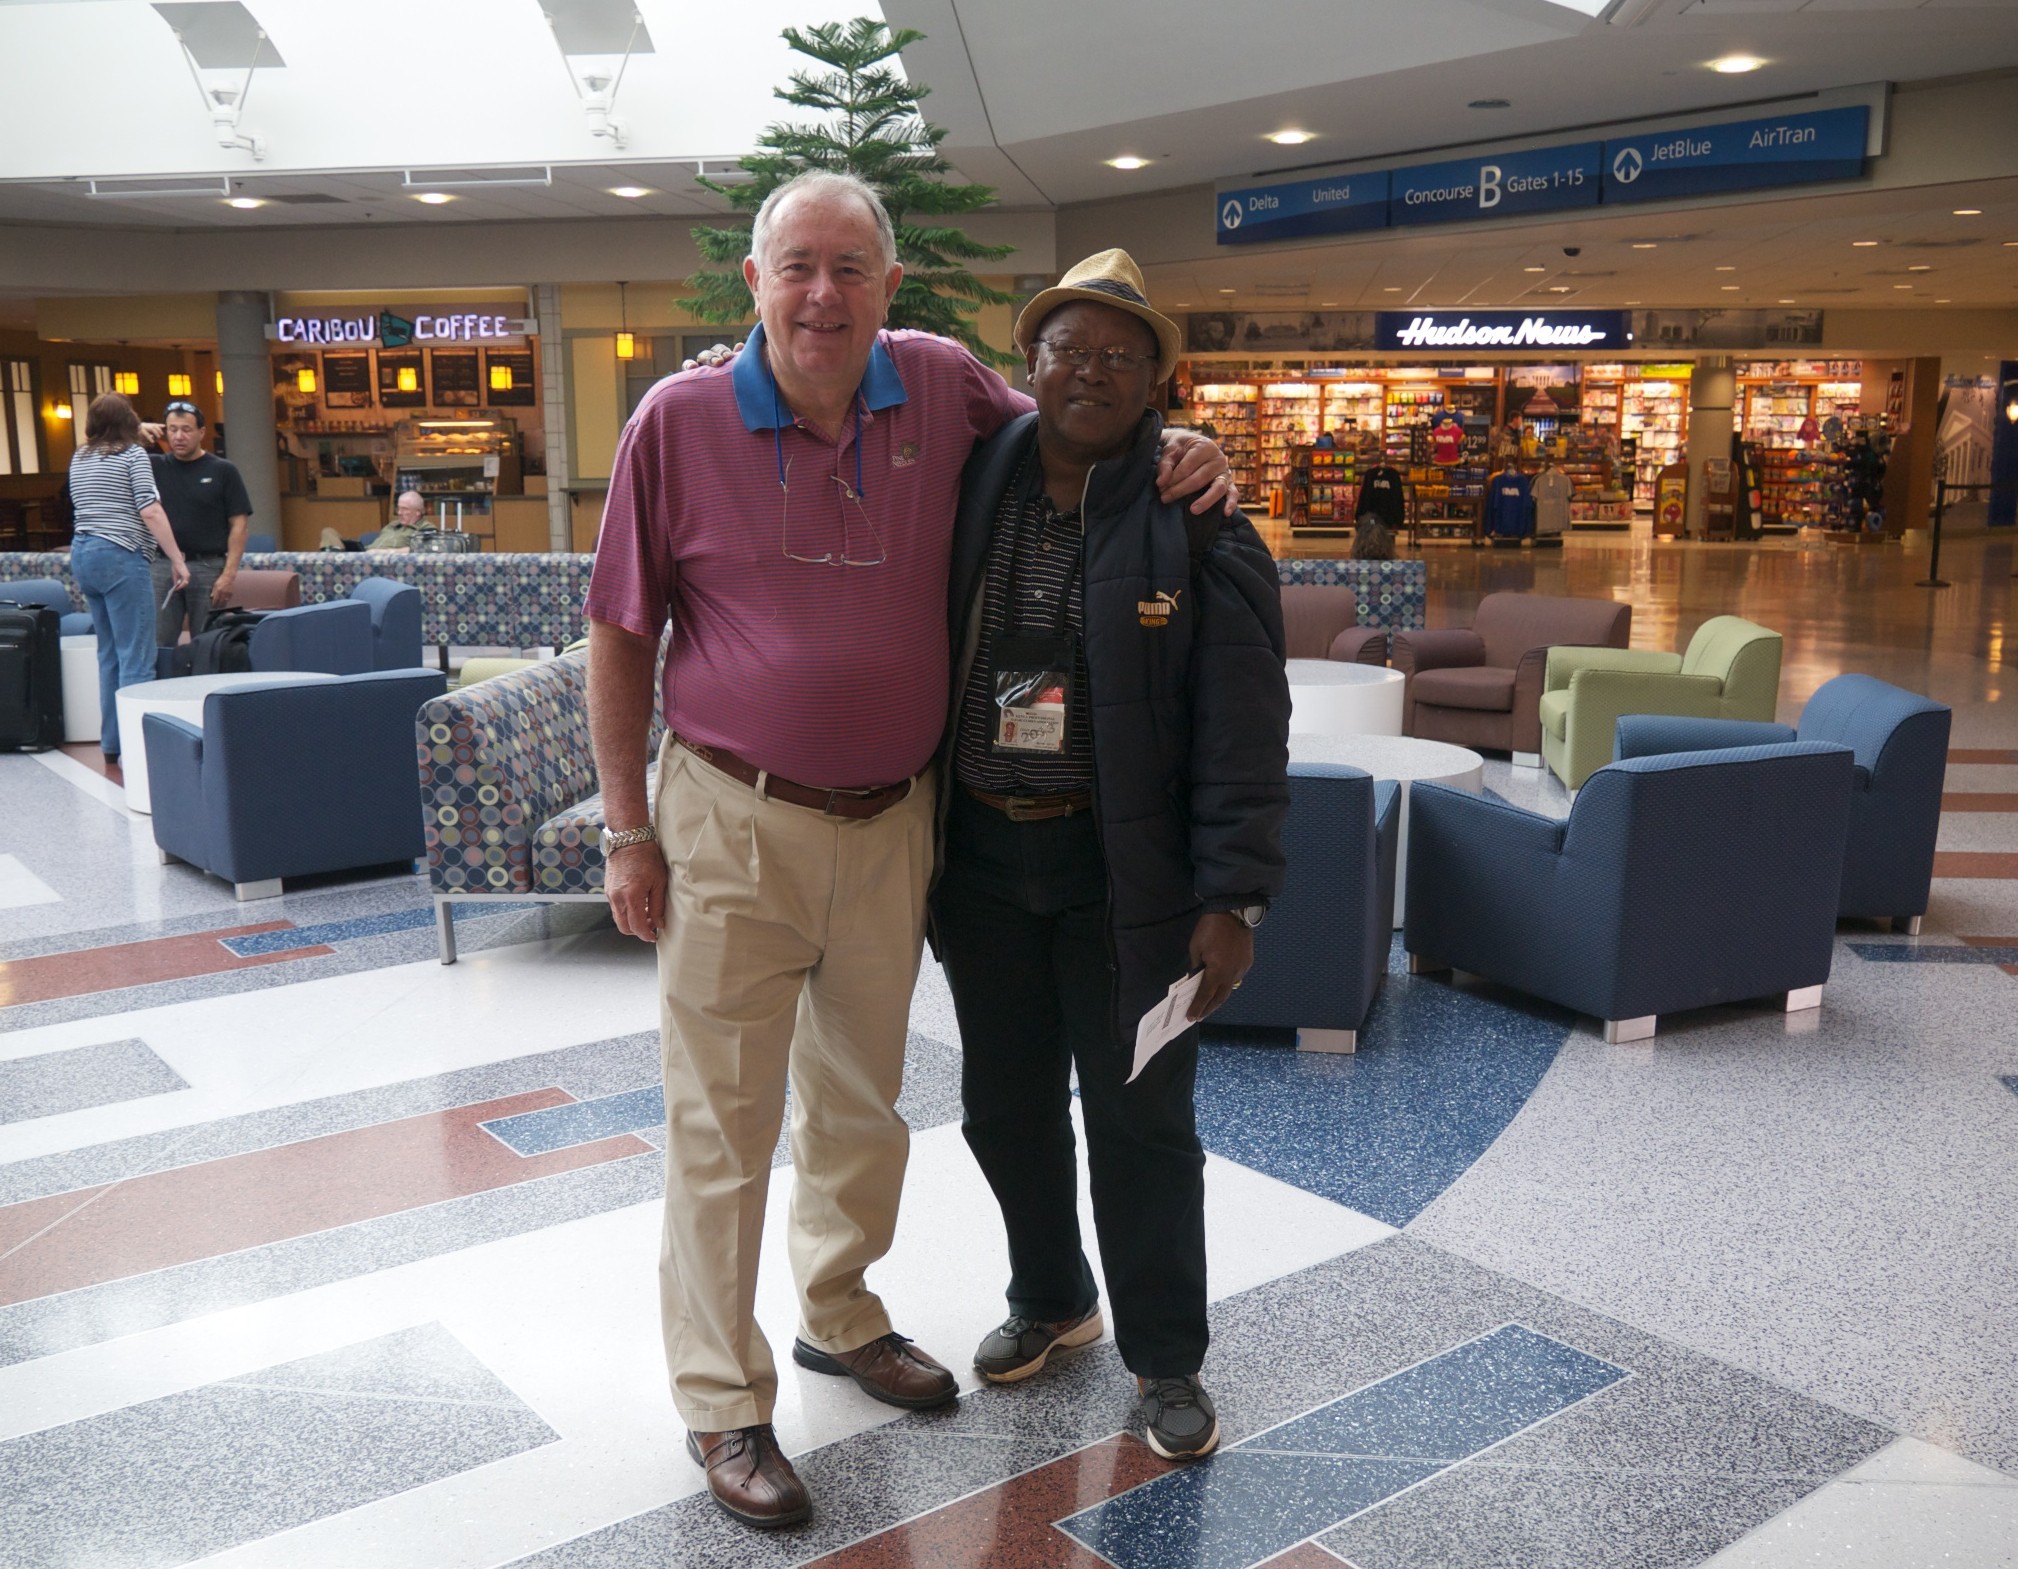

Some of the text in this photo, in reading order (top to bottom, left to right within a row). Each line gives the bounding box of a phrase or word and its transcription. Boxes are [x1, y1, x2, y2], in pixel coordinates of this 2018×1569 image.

[1650, 126, 1816, 161] JetBlue AirTran
[1248, 184, 1351, 212] Delta United
[1404, 165, 1586, 208] Concourse B Gates 1-15
[278, 314, 509, 344] CARIBOU COFFEE
[1396, 317, 1606, 346] Hudson News
[1137, 601, 1171, 615] PUMA
